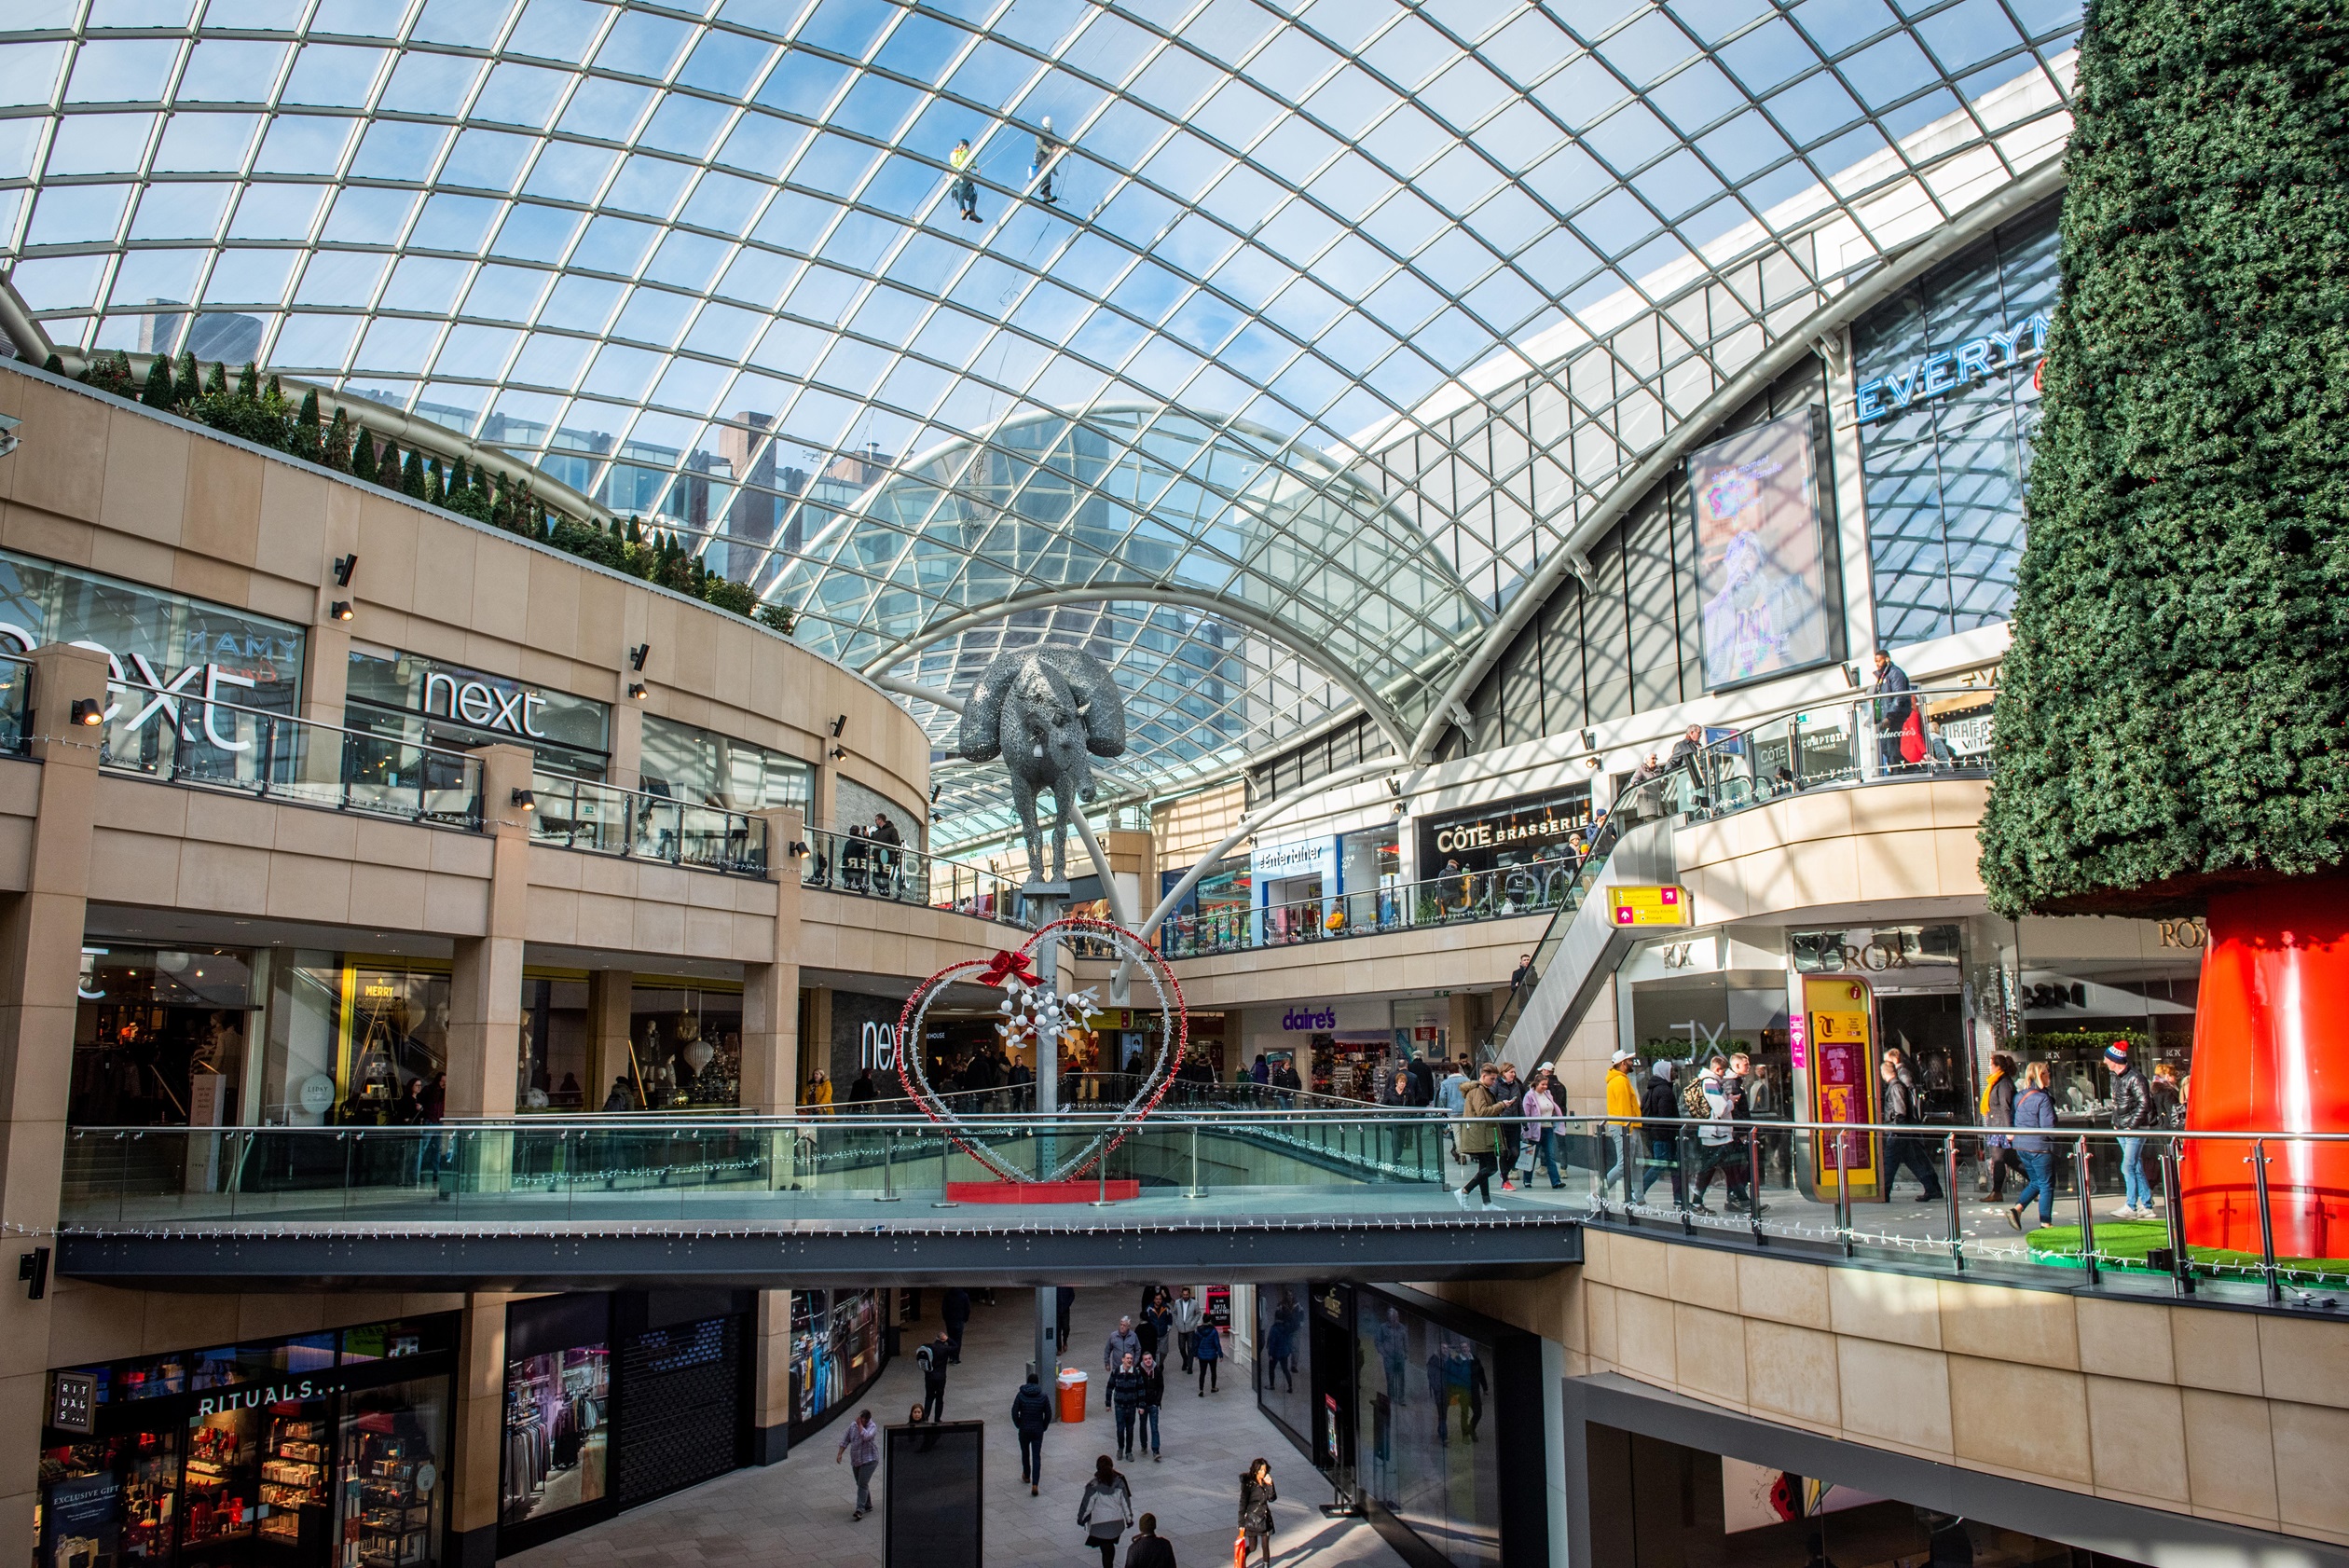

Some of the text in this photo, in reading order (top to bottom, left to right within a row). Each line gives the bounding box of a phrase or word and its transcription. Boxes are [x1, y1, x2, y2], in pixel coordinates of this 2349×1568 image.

[424, 672, 546, 737] next
[1802, 732, 1848, 749] COMPTOIR
[1760, 745, 1787, 763] CÔTE
[1437, 814, 1589, 853] CÔTE BRASSERIE
[1266, 846, 1323, 869] Entertainer
[364, 985, 393, 997] MERRY
[1283, 1007, 1336, 1031] claire's
[2045, 1051, 2060, 1060] ROX
[2166, 1049, 2181, 1057] ROX
[199, 1381, 346, 1416] RITUALS...
[53, 1490, 99, 1506] EXCLUSIVE
[100, 1484, 120, 1495] GIFT
